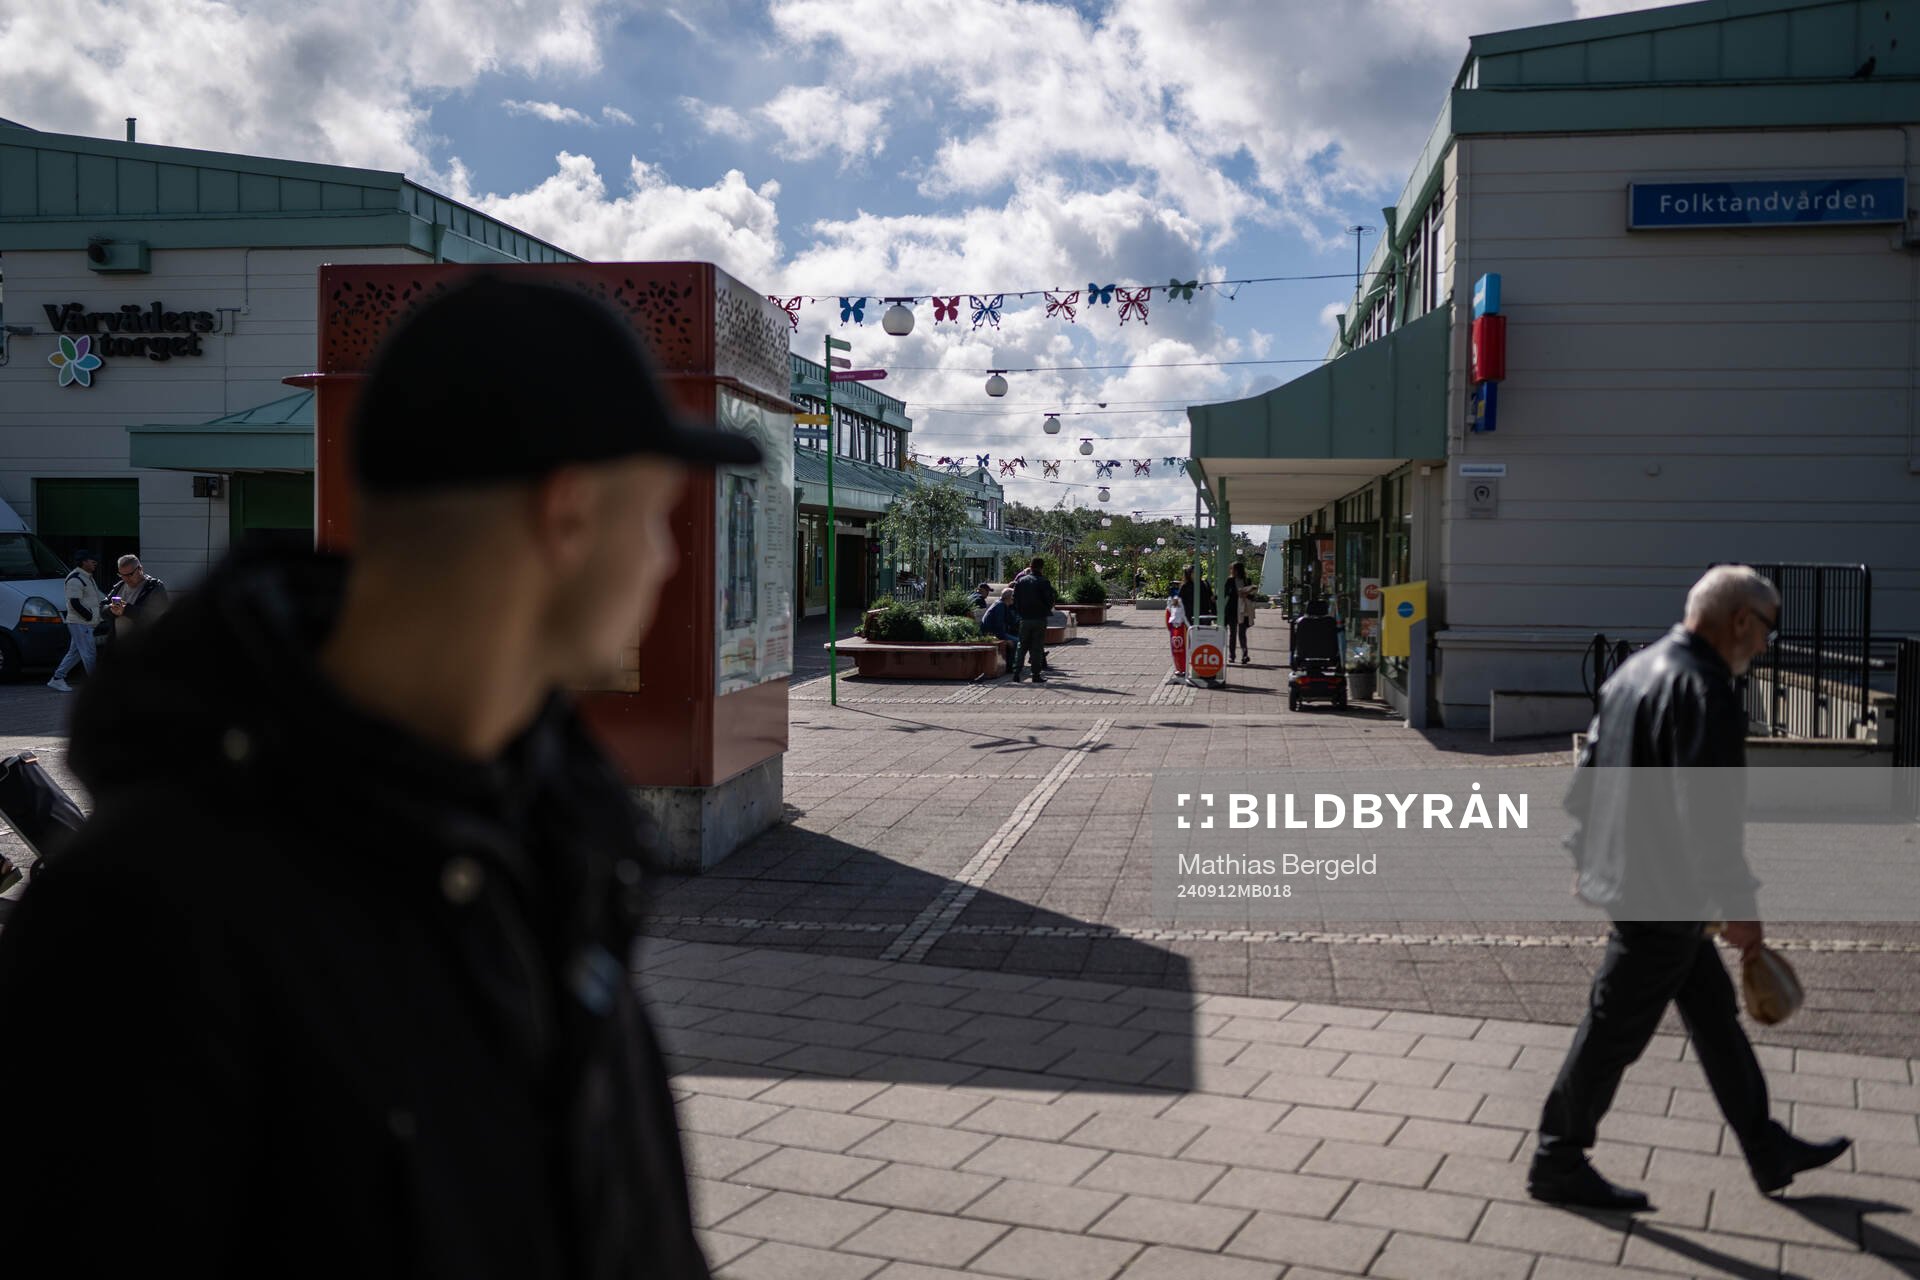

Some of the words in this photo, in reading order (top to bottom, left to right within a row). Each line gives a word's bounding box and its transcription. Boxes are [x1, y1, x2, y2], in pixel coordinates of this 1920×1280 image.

[1660, 189, 1876, 214] Folktandvården
[100, 331, 203, 361] torget
[1194, 648, 1220, 665] ria
